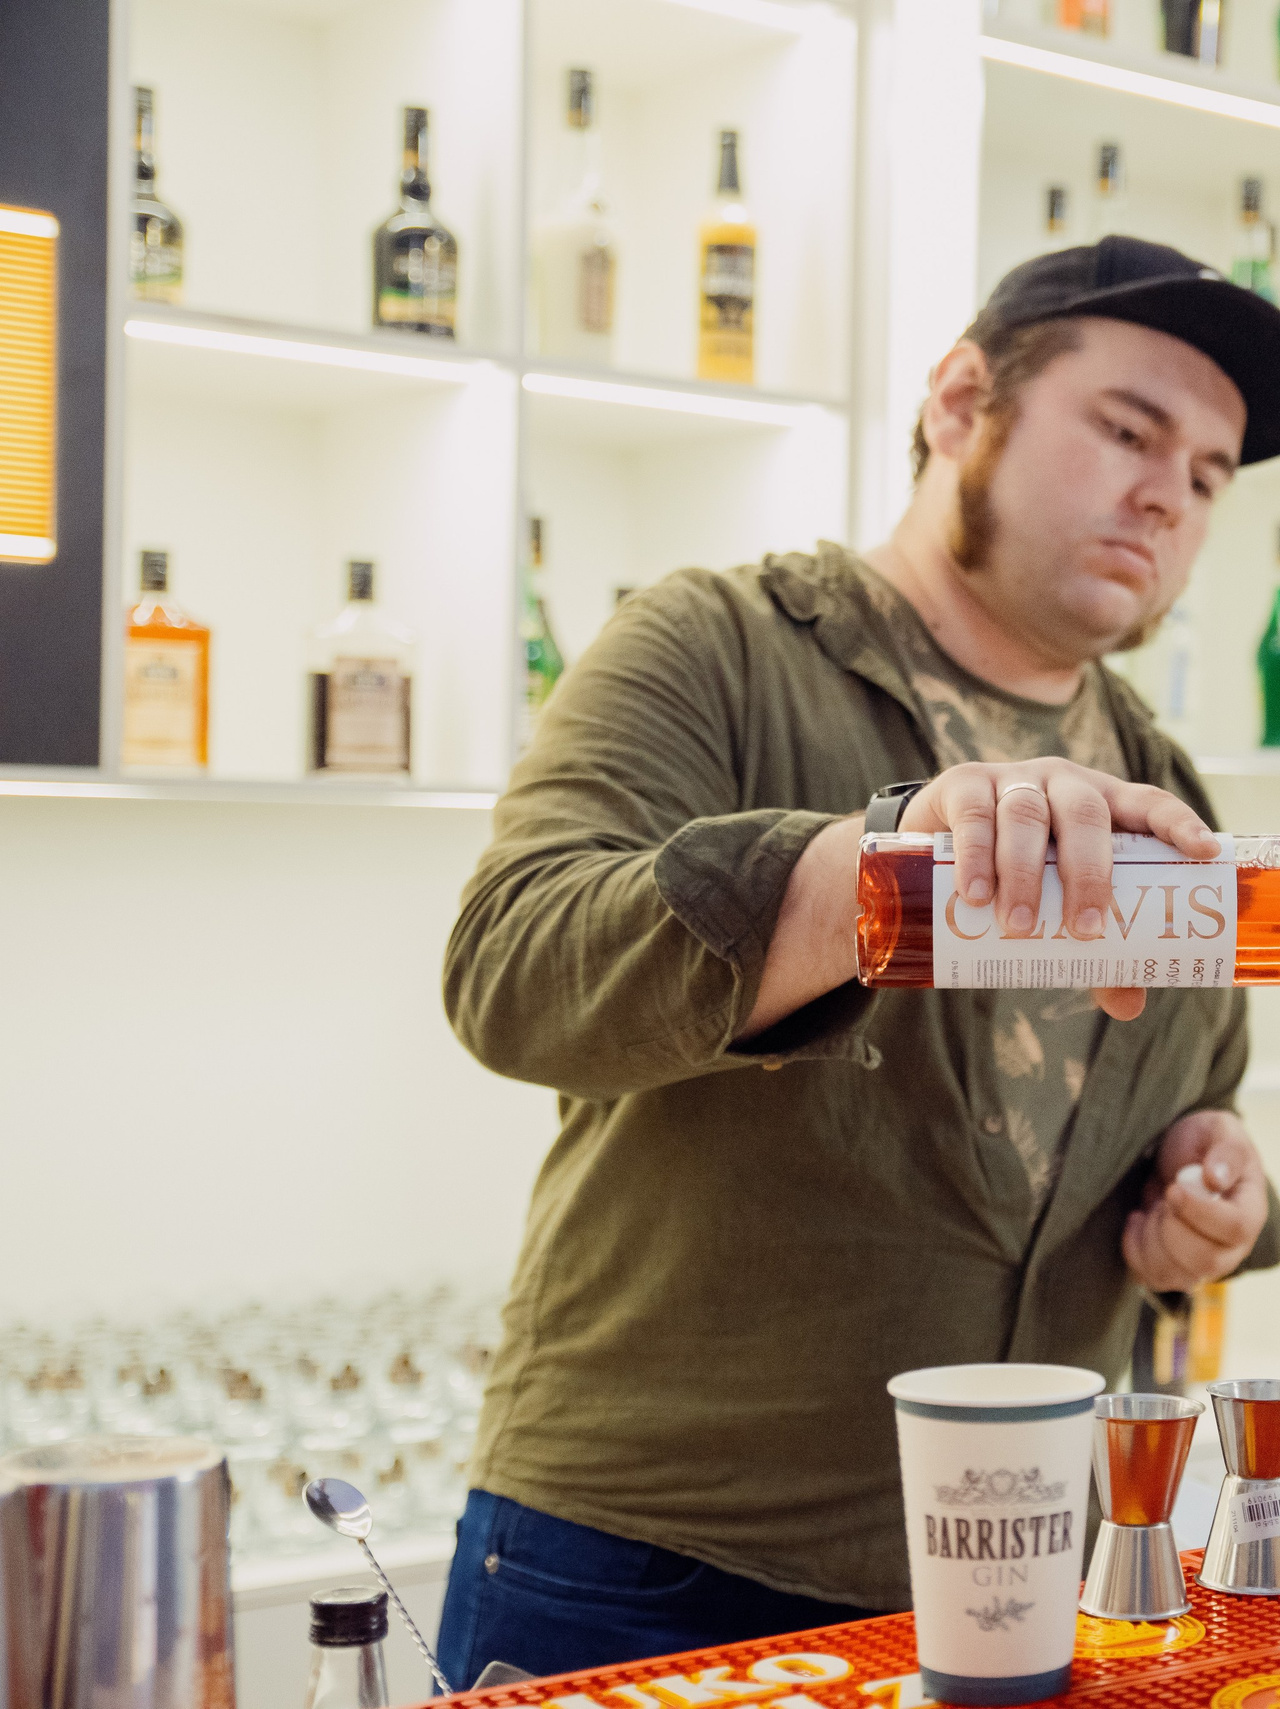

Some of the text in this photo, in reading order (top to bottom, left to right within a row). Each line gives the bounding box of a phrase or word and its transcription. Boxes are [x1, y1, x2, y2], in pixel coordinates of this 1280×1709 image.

[944, 884, 1226, 941] CVIS
[925, 1510, 1073, 1562] BARRISTER
[972, 1564, 1029, 1587] GIN
